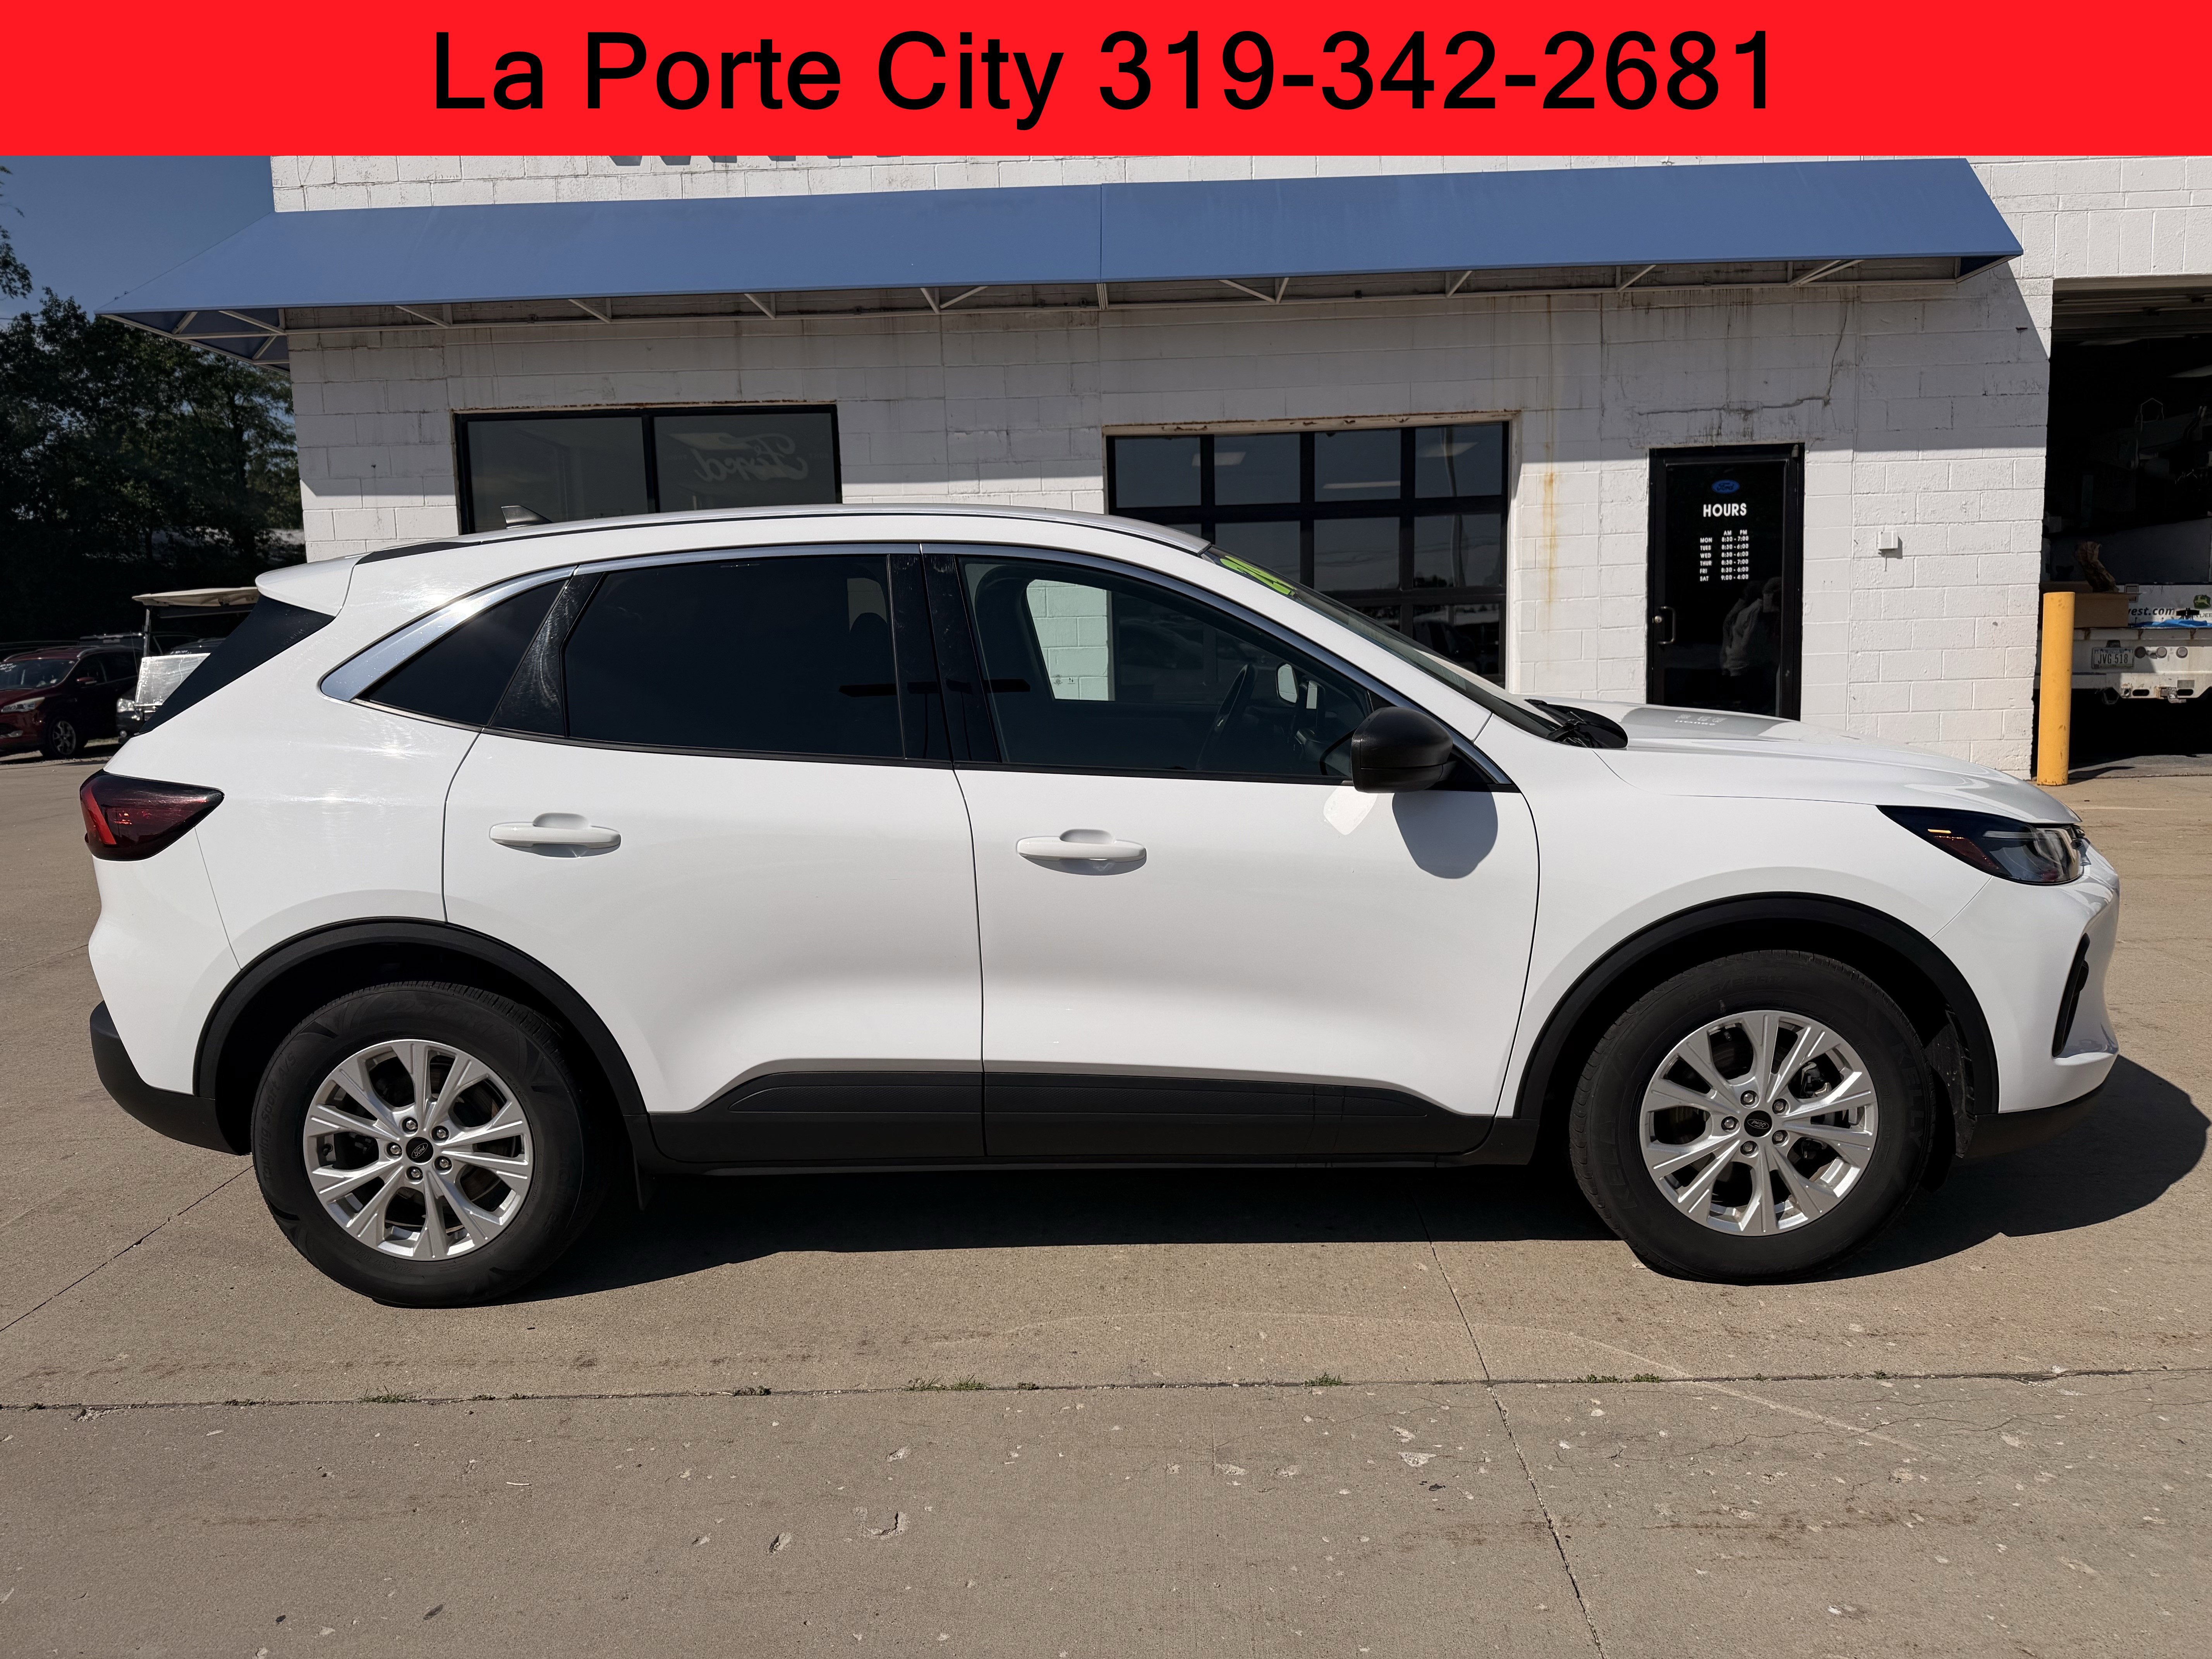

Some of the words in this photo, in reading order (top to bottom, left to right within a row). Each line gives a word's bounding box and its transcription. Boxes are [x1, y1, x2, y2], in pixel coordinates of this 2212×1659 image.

[1703, 503, 1747, 517] HOURS
[2098, 654, 2111, 664] JVG
[2115, 654, 2128, 663] 518
[1891, 1041, 1925, 1149] KELLY
[261, 1079, 282, 1126] Sport
[1750, 1120, 1766, 1128] Ford
[259, 1127, 273, 1183] Touring
[414, 1144, 425, 1157] Ford
